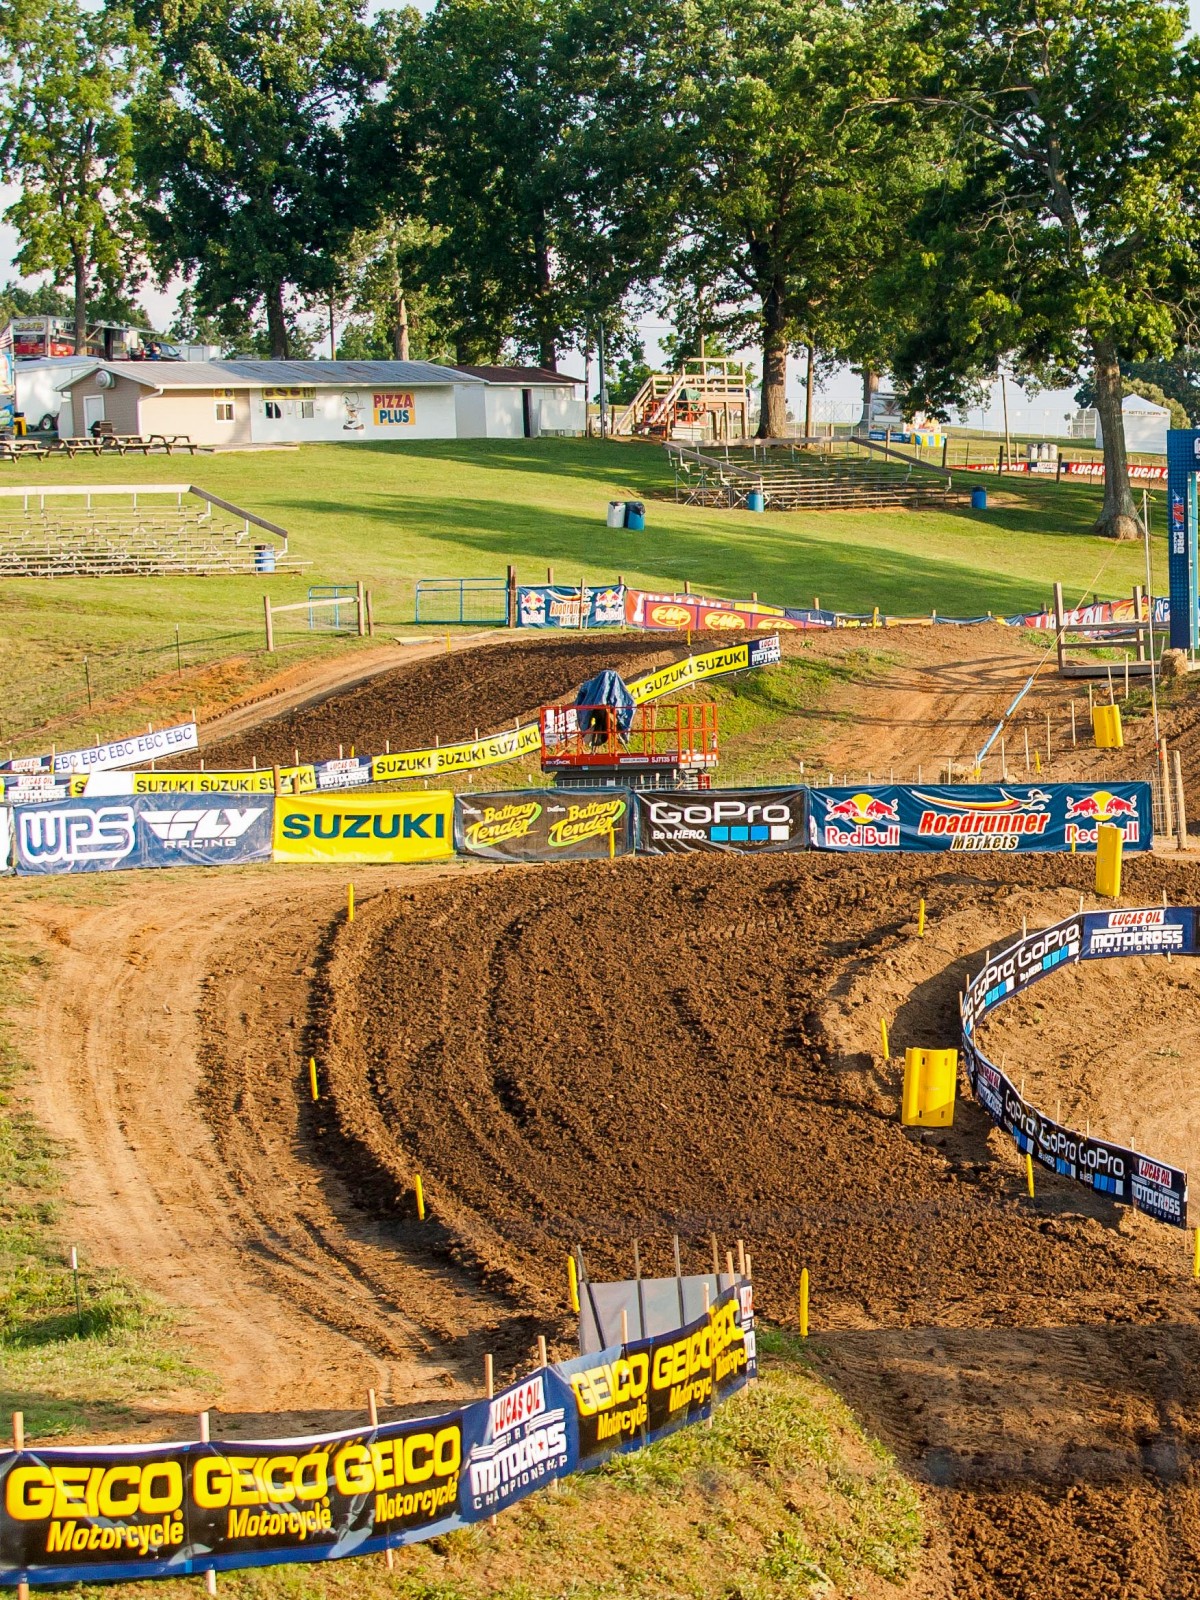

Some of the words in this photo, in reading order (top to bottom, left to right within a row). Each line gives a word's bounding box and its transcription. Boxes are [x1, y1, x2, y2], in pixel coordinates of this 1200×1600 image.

[374, 394, 414, 408] PIZZA
[379, 409, 409, 424] PLUS
[1128, 466, 1162, 479] LUCAS
[696, 650, 747, 673] SUZUKI
[54, 754, 78, 771] EBC
[82, 747, 106, 767] EBC
[109, 742, 134, 760] EBC
[138, 734, 163, 753] EBC
[166, 727, 193, 746] EBC
[376, 757, 431, 775] SUZUKI
[438, 747, 486, 767] SUZUKI
[488, 731, 539, 757] SUZUKI
[136, 779, 195, 793] SUZUKI
[200, 778, 255, 792] SUZUKI
[139, 807, 268, 839] FLY
[483, 802, 537, 825] Battery
[567, 800, 621, 822] Battery
[649, 801, 790, 824] GoPro
[917, 810, 1052, 836] Roadrunner
[20, 806, 136, 864] WPS
[282, 813, 445, 840] SUZUKI
[465, 818, 530, 845] Tender
[549, 816, 614, 843] Tender
[653, 830, 665, 839] Be
[673, 829, 707, 840] HERO.
[163, 838, 237, 849] RACING
[950, 834, 1019, 852] Markets
[1111, 913, 1144, 926] LUCAS
[1145, 911, 1161, 924] OIL
[1089, 944, 1183, 955] CHAMPIONSHIP
[1090, 930, 1183, 949] MOTOCROSS
[974, 958, 1015, 1004] GoPro
[1018, 924, 1080, 969] GoPro
[1005, 1090, 1036, 1136] GoPro
[1039, 1122, 1077, 1162] GoPro
[1079, 1142, 1126, 1179] GoPro
[1140, 1160, 1160, 1182] LUCAS
[1161, 1169, 1171, 1187] OIL
[570, 1353, 650, 1417] GEICO
[652, 1326, 713, 1391] GEICO
[494, 1387, 525, 1431] LUCAS
[526, 1377, 542, 1415] OIL
[669, 1379, 712, 1414] Motorcyc
[469, 1421, 567, 1496] MOTOCROSS
[6, 1462, 184, 1521] GEICO
[194, 1451, 330, 1509] GEICO
[334, 1425, 461, 1496] GEICO
[473, 1455, 568, 1510] CHAMPIONSHIP
[45, 1516, 184, 1556] Motorcycle
[227, 1504, 332, 1542] Motorcycle
[375, 1476, 458, 1524] Motorcycle
